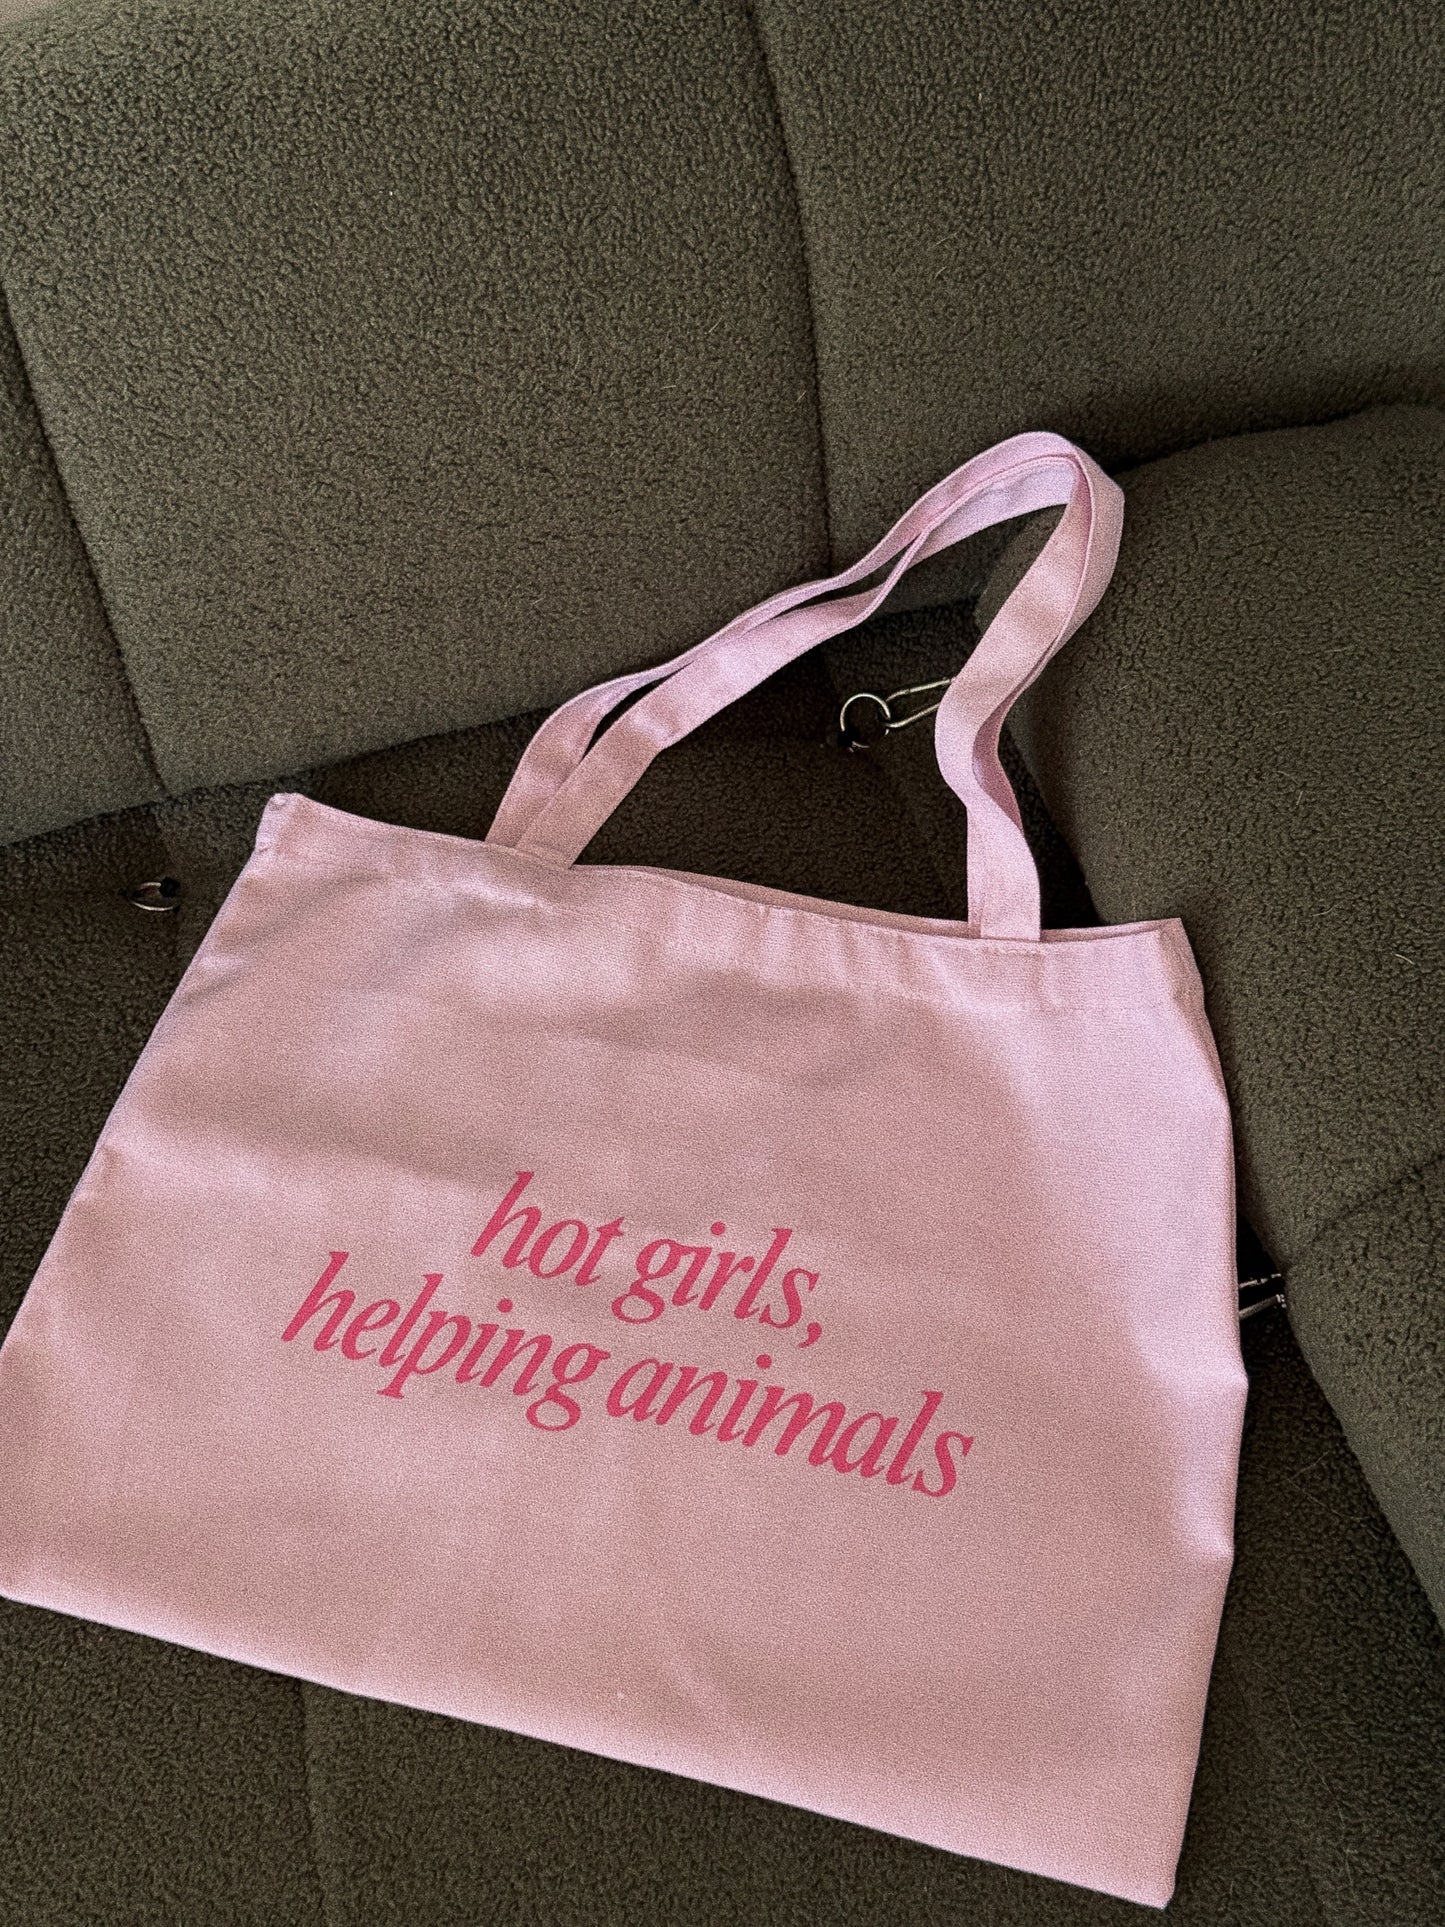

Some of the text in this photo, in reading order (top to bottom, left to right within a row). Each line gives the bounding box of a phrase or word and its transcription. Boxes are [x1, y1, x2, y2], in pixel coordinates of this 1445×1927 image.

[471, 1171, 823, 1348] hot girls,
[281, 1251, 974, 1497] helping animals
